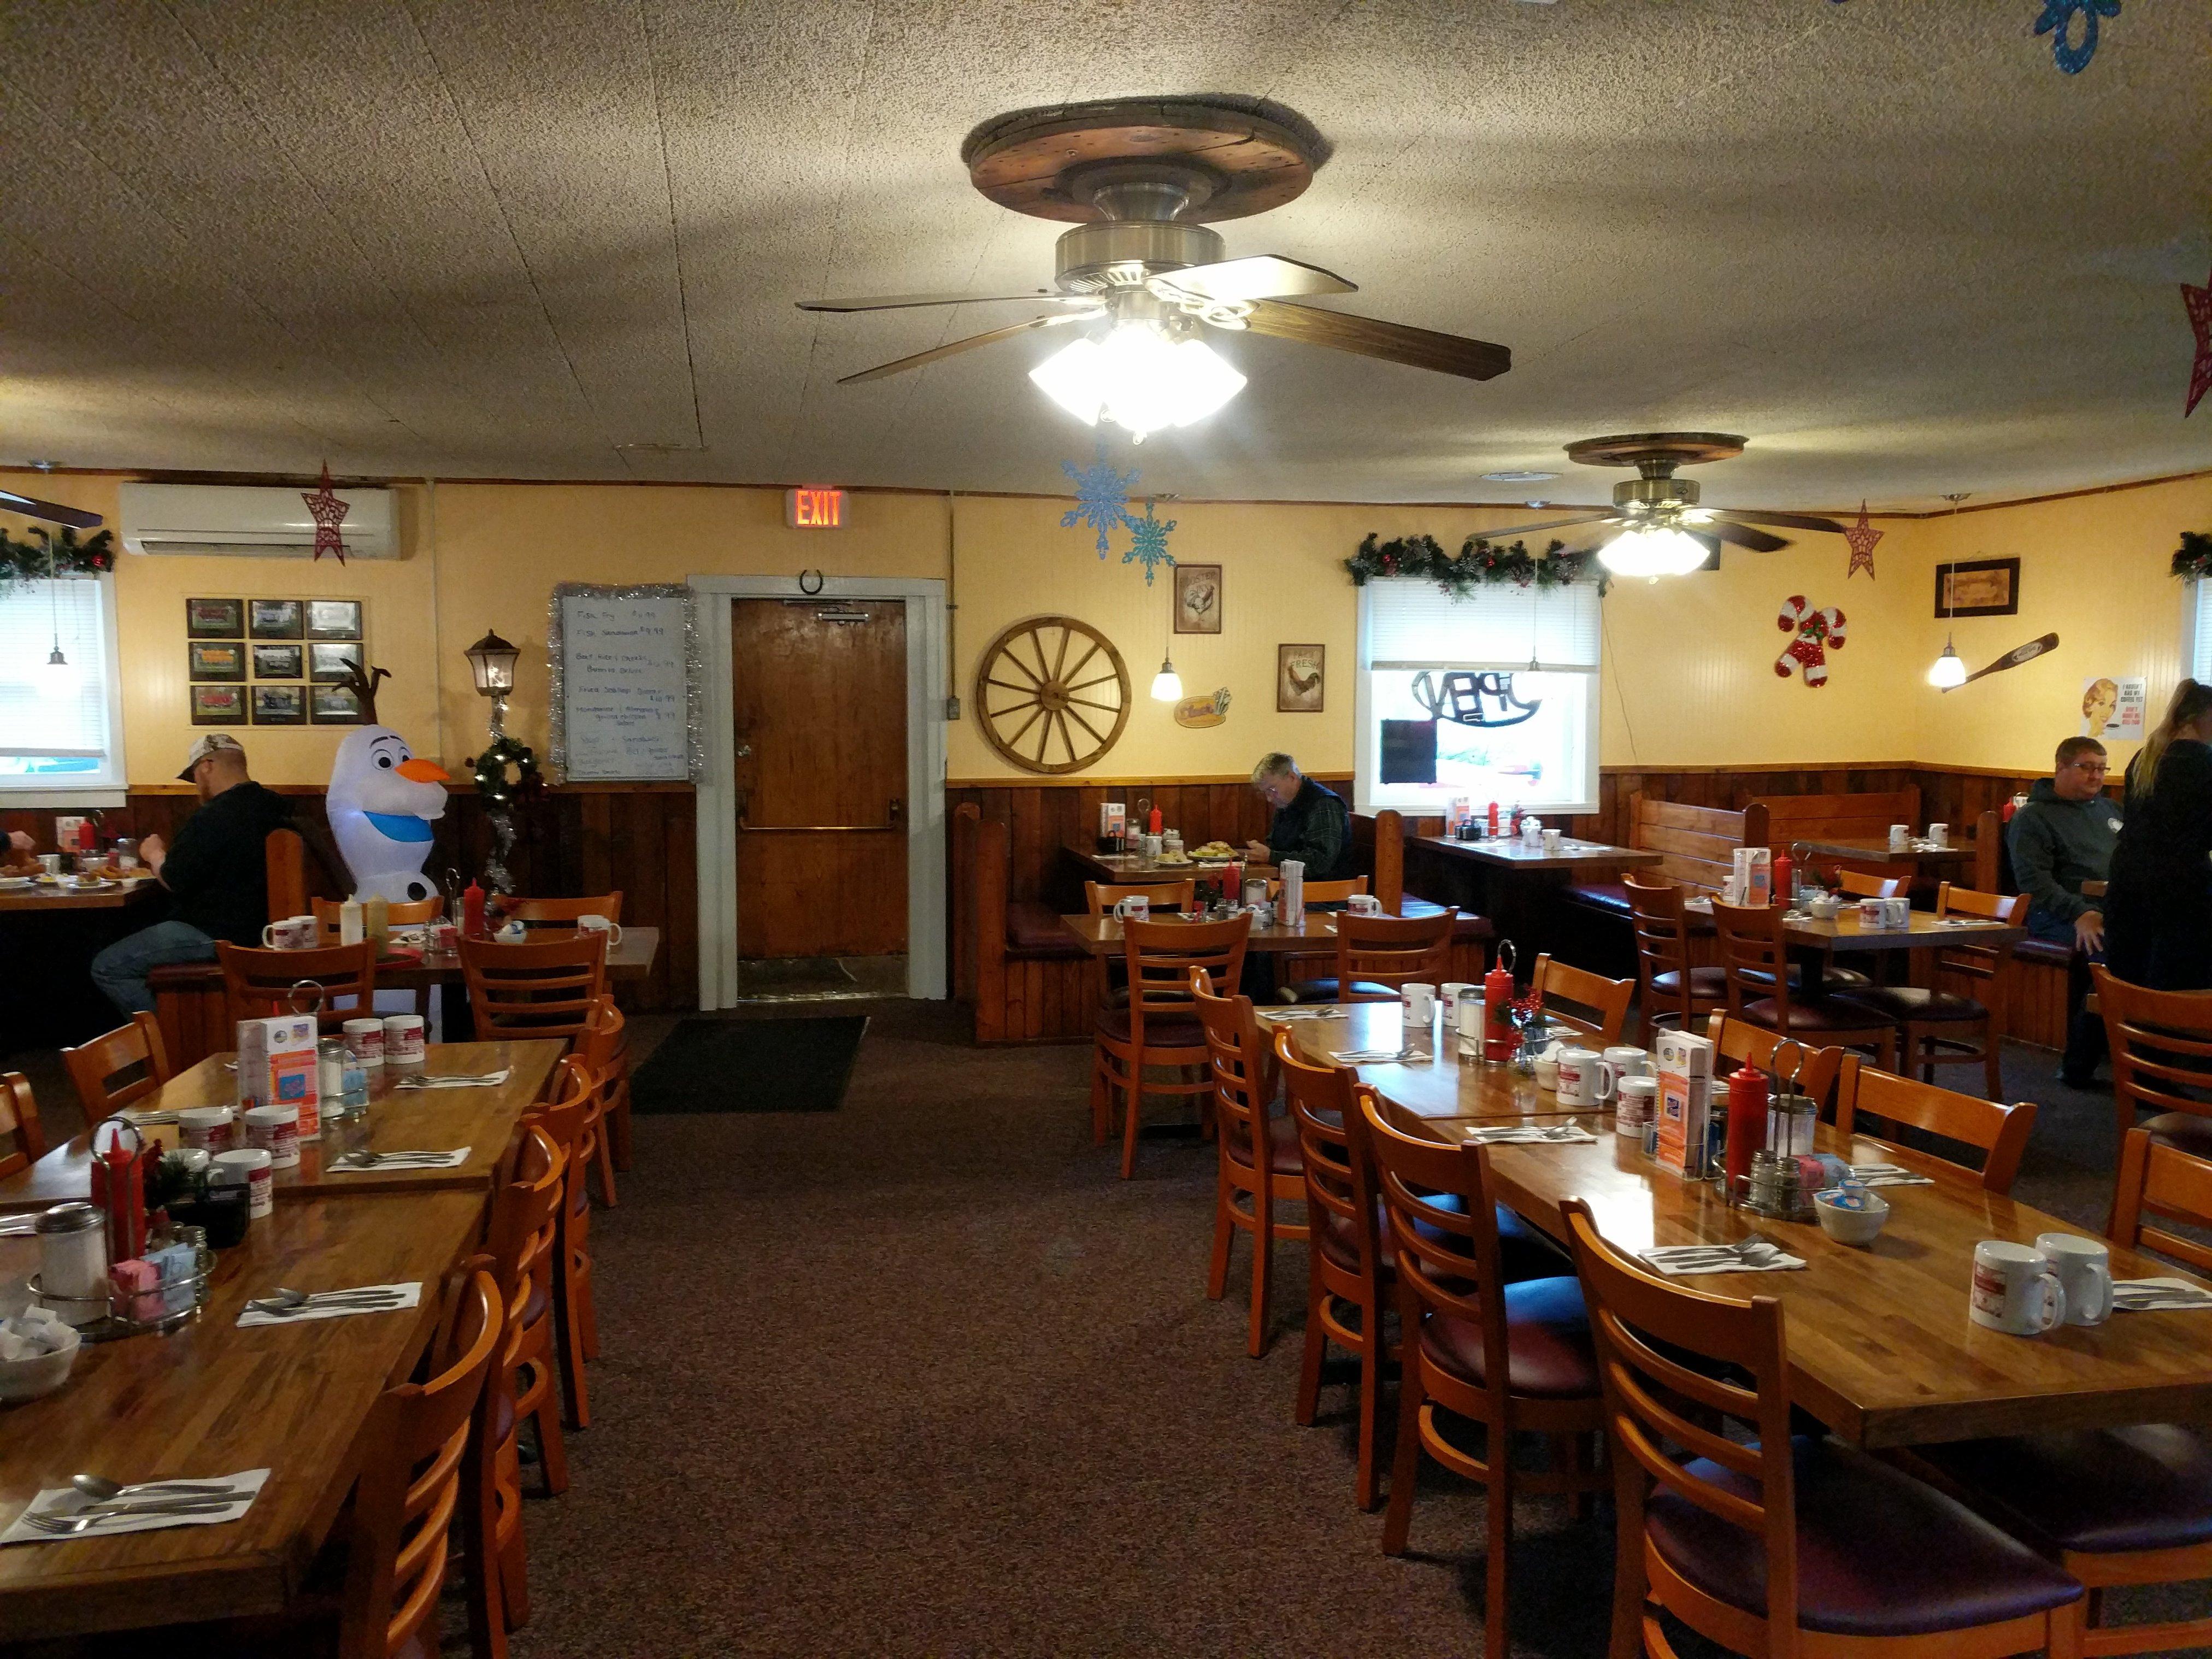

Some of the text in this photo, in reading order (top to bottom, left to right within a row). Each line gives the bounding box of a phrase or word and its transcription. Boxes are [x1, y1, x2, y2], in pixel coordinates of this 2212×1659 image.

[797, 490, 841, 525] EXIT
[577, 611, 598, 619] Fish
[602, 611, 615, 621] Fry
[1290, 658, 1321, 670] FRESH
